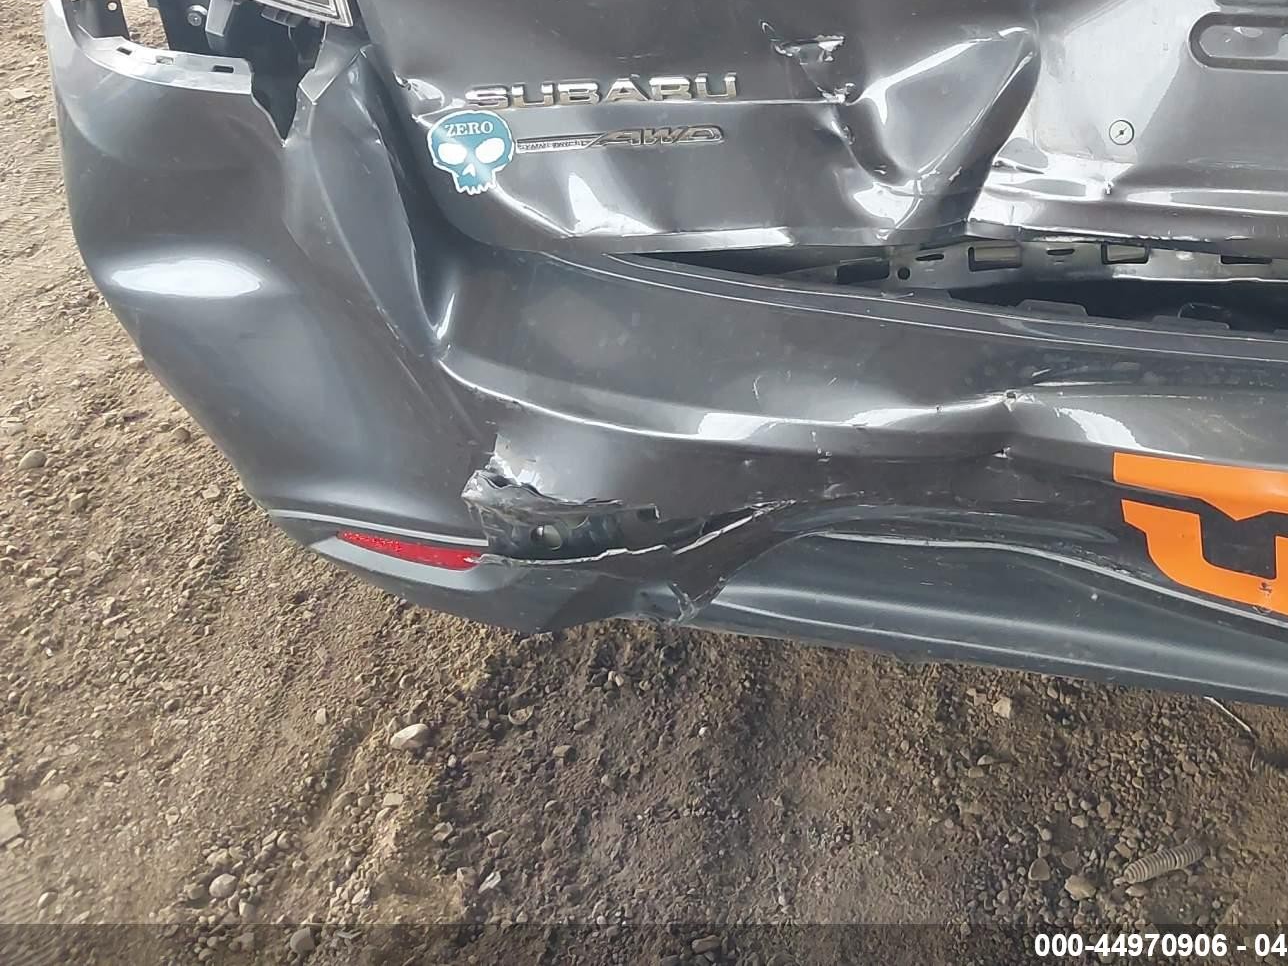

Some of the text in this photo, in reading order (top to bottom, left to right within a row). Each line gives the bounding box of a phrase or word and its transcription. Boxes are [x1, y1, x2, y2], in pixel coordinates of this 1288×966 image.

[465, 73, 738, 109] SUBARU
[445, 121, 494, 138] ZERO
[602, 125, 724, 145] AWD
